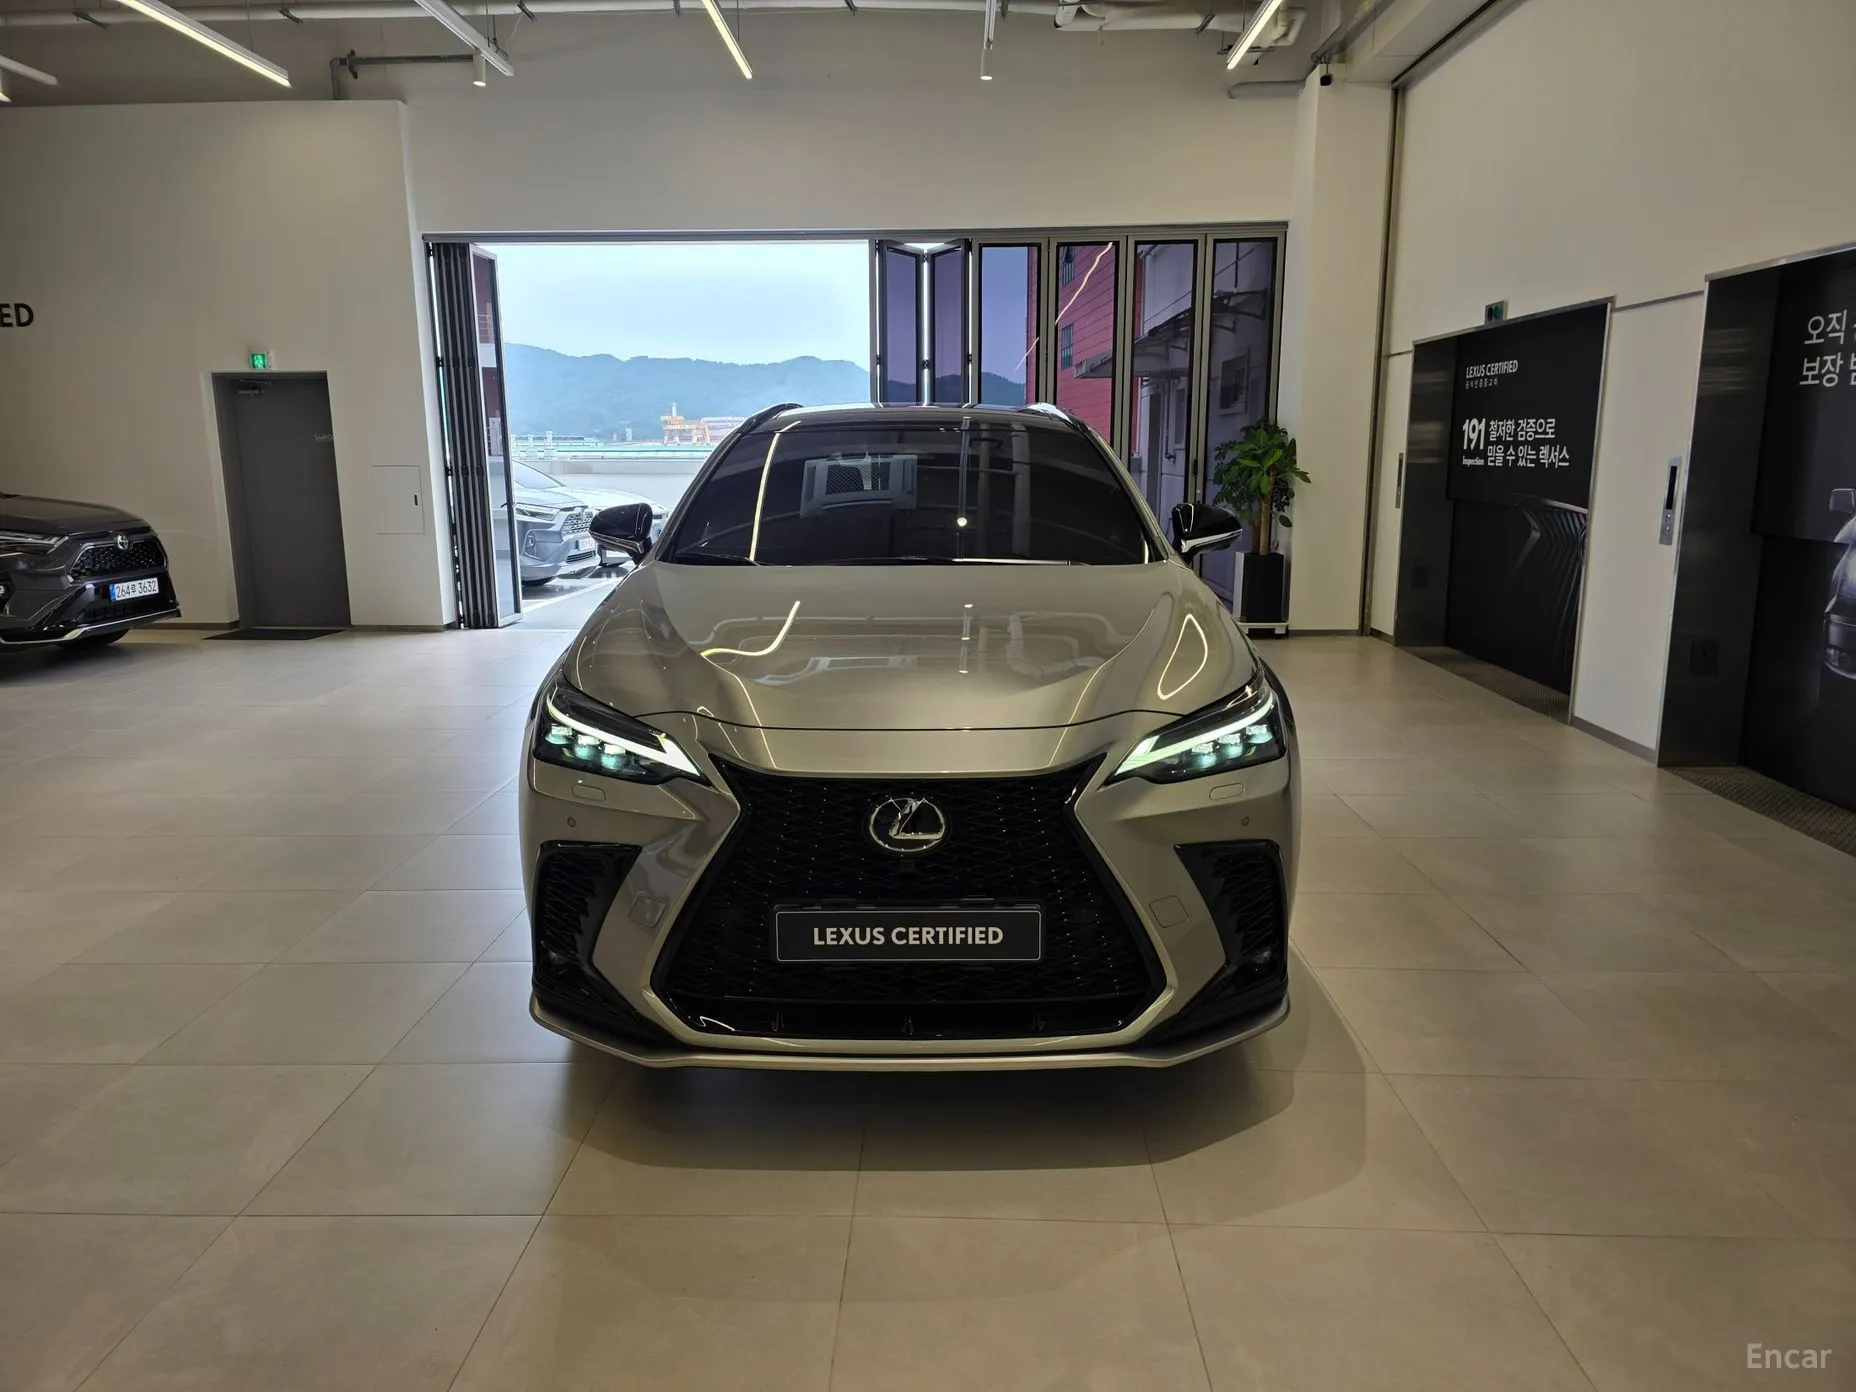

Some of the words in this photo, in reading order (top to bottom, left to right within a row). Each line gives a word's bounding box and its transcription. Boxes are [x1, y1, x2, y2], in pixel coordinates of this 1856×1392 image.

[0, 302, 34, 328] ED
[1804, 309, 1848, 345] 오직
[1466, 364, 1485, 378] LEXUS
[1486, 360, 1518, 376] CERTIFIED
[1799, 351, 1844, 388] 보장
[1462, 418, 1486, 451] 191
[1489, 419, 1515, 442] 철저한
[1517, 418, 1556, 441] 검증으로
[1487, 444, 1505, 467] 믿을
[1506, 445, 1516, 467] 수
[1517, 444, 1537, 468] 있는
[1539, 444, 1570, 469] 렉서스
[138, 580, 157, 594] 3632
[813, 927, 885, 946] LEXUS
[891, 926, 1004, 945] CERTIFIED
